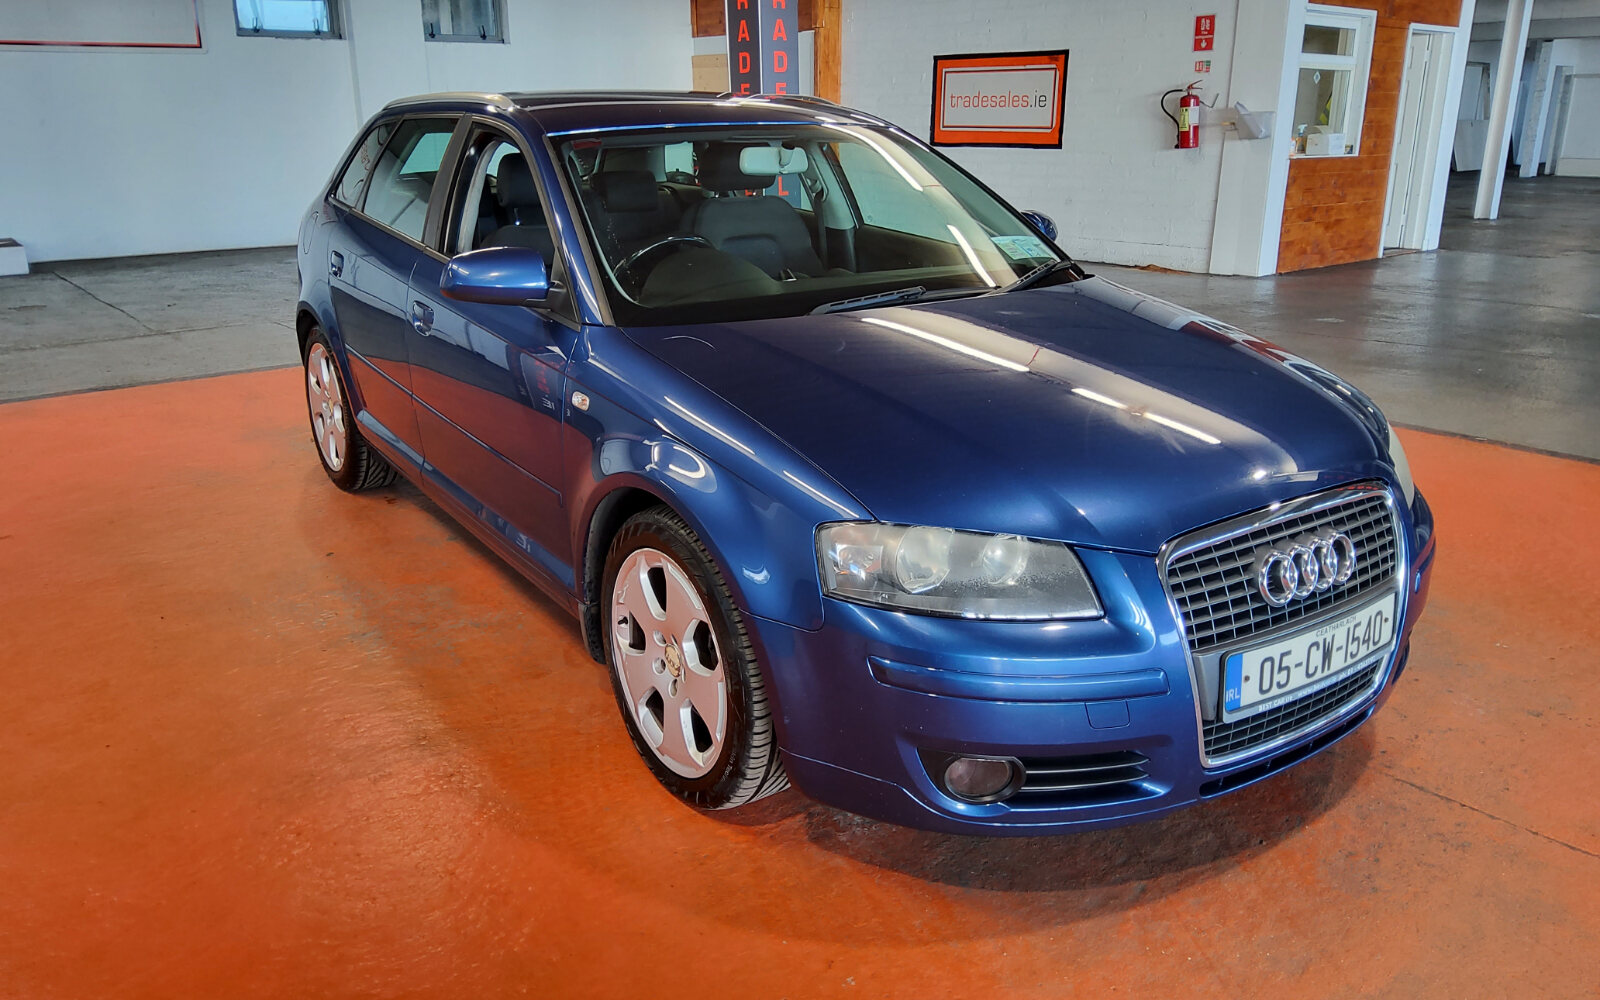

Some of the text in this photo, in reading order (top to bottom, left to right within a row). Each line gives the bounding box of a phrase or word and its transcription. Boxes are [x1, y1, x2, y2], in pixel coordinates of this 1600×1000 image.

[950, 90, 1047, 108] tradesales.ie
[1258, 610, 1384, 695] 05-CW-1540
[1225, 688, 1240, 703] IRL
